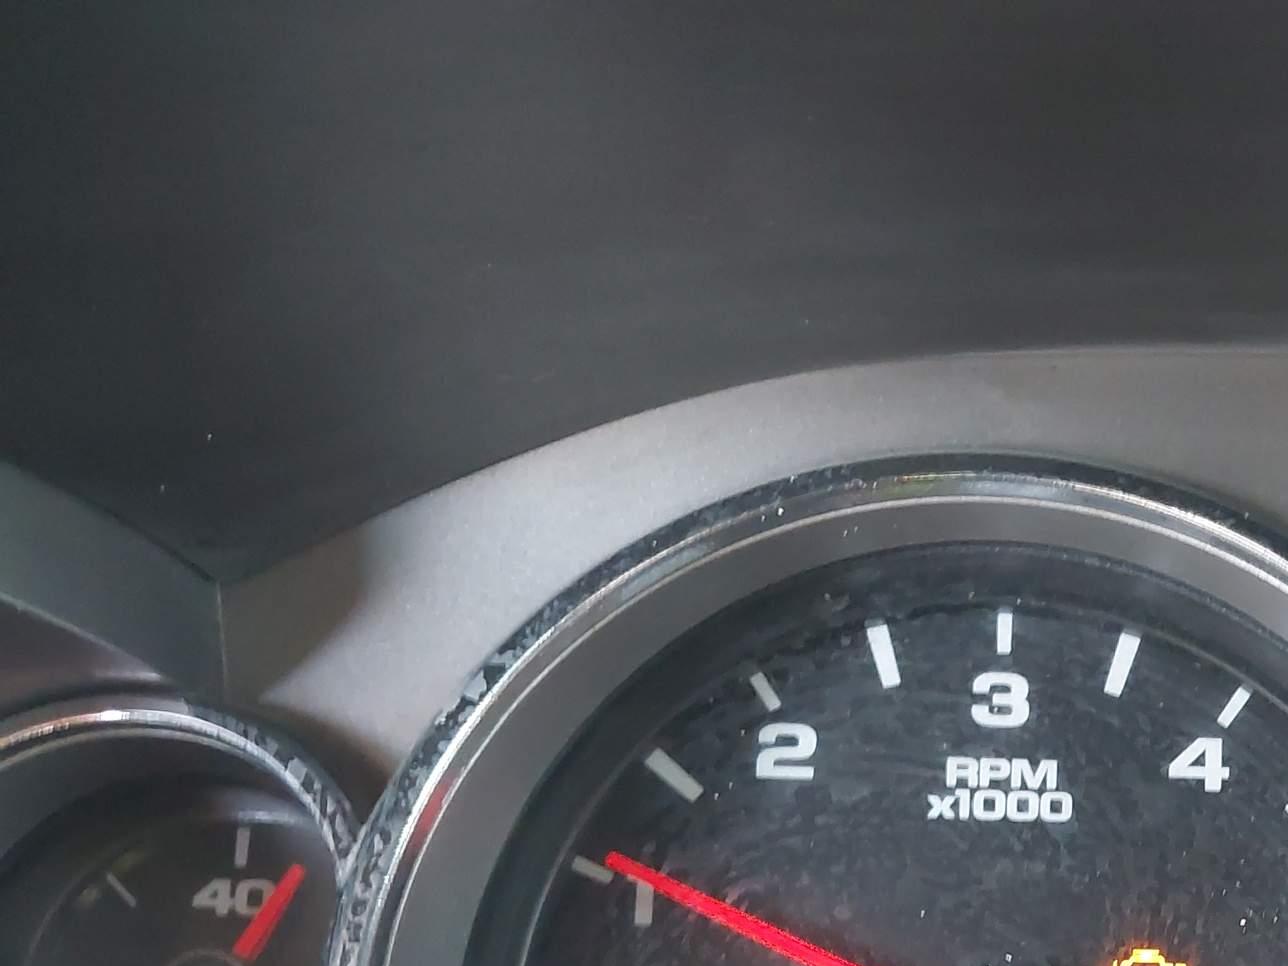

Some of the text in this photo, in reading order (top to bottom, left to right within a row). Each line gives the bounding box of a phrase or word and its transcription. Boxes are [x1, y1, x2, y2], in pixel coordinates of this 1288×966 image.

[971, 672, 1030, 728] 3
[755, 722, 818, 780] 2
[945, 757, 1058, 790] RPM
[1168, 737, 1230, 792] 4
[926, 789, 1074, 823] x1000
[192, 878, 275, 916] 40
